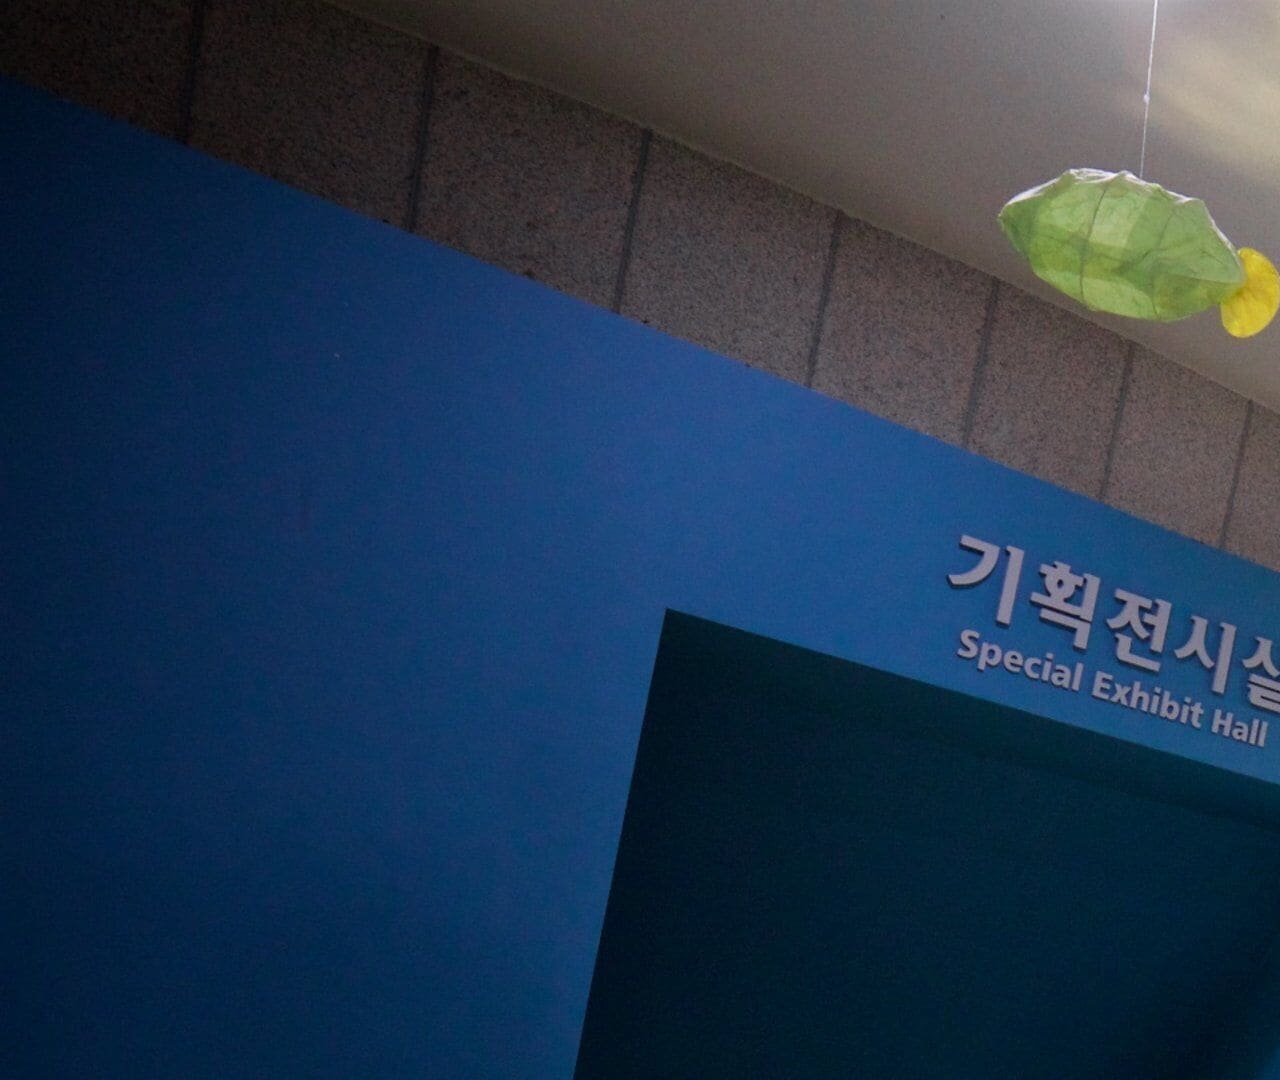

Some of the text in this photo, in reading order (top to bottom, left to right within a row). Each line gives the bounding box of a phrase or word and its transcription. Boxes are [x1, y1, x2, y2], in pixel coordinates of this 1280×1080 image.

[957, 629, 1269, 748] Special Exhibit Hall
